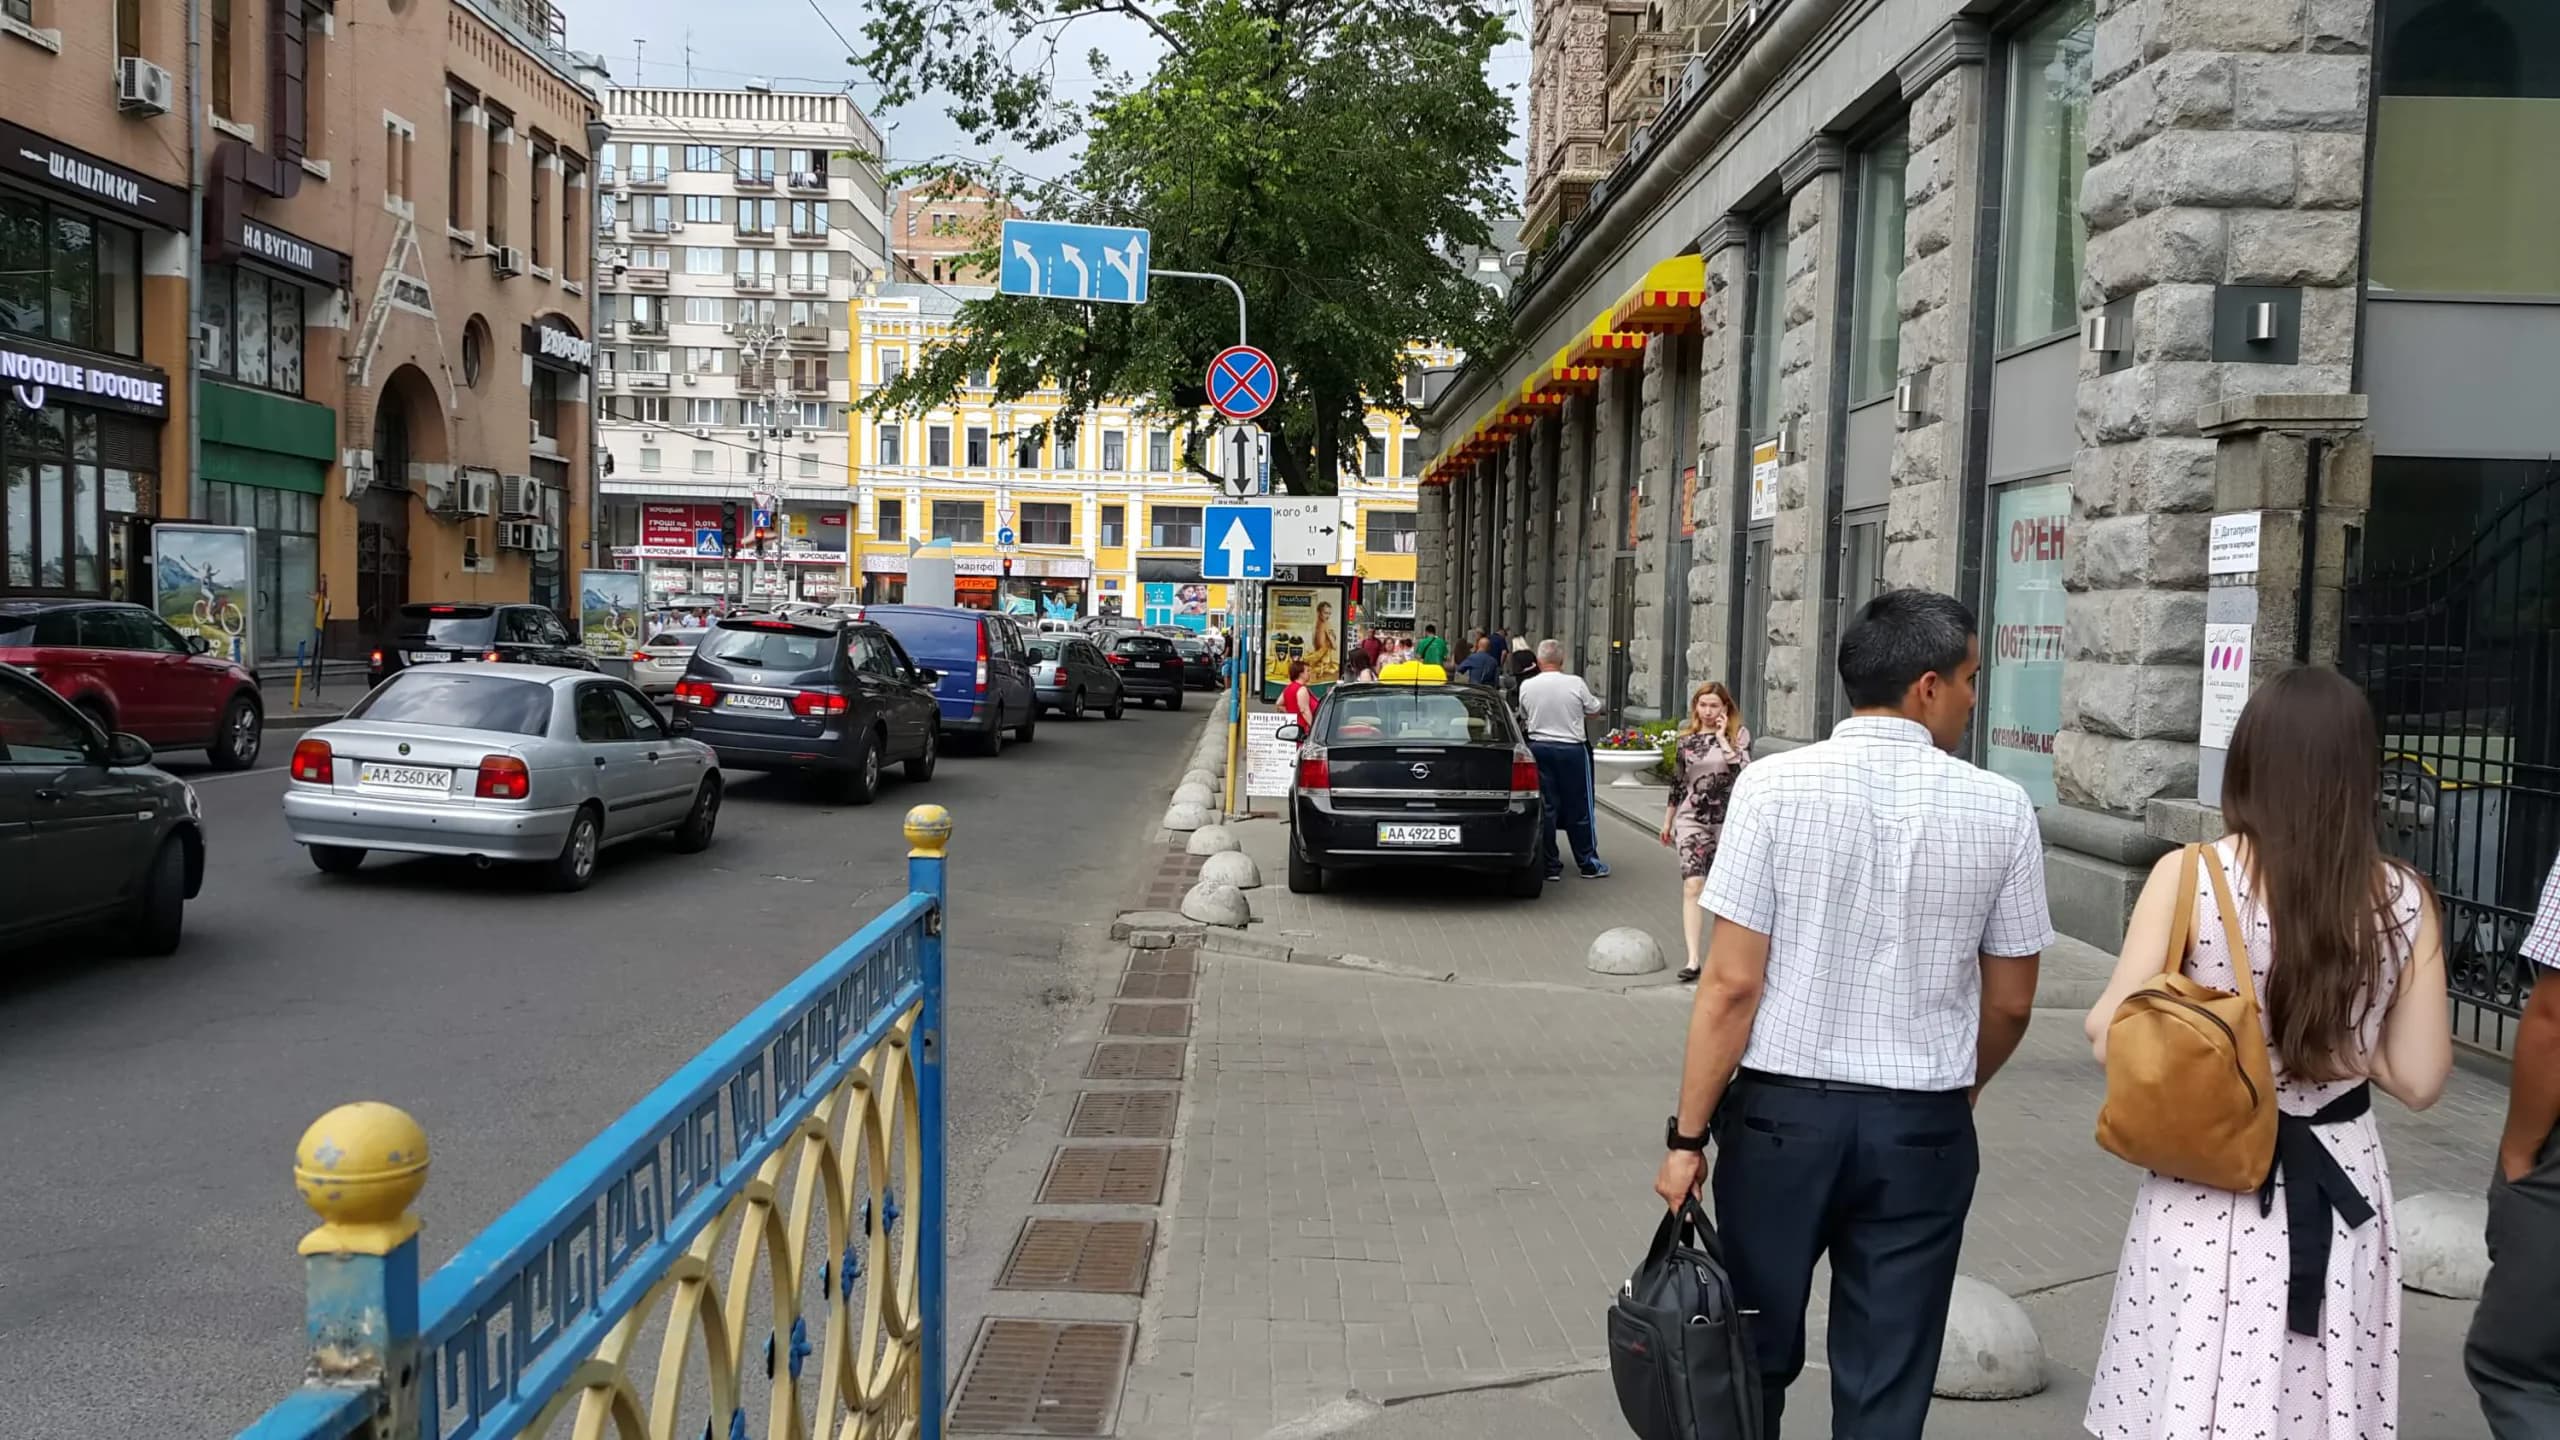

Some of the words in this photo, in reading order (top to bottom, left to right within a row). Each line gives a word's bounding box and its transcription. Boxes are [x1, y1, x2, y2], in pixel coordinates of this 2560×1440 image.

[49, 151, 138, 205] ШАШЛИКИ
[243, 224, 262, 253] НА
[264, 234, 313, 270] ВУГІЛЛІ
[0, 352, 84, 391] NOODLE
[87, 369, 163, 406] DOODLE
[1305, 505, 1318, 514] 0,8
[1308, 525, 1318, 535] 1,1
[2011, 515, 2064, 562] ОРЕН
[1307, 548, 1316, 557] 1,1
[1995, 624, 2029, 669] (067)
[733, 696, 746, 705] AA
[372, 768, 391, 782] AA
[394, 769, 425, 785] 2560
[427, 773, 448, 787] KK
[1387, 827, 1405, 840] AA
[1409, 828, 1435, 840] 4922
[1439, 828, 1456, 841] BC
